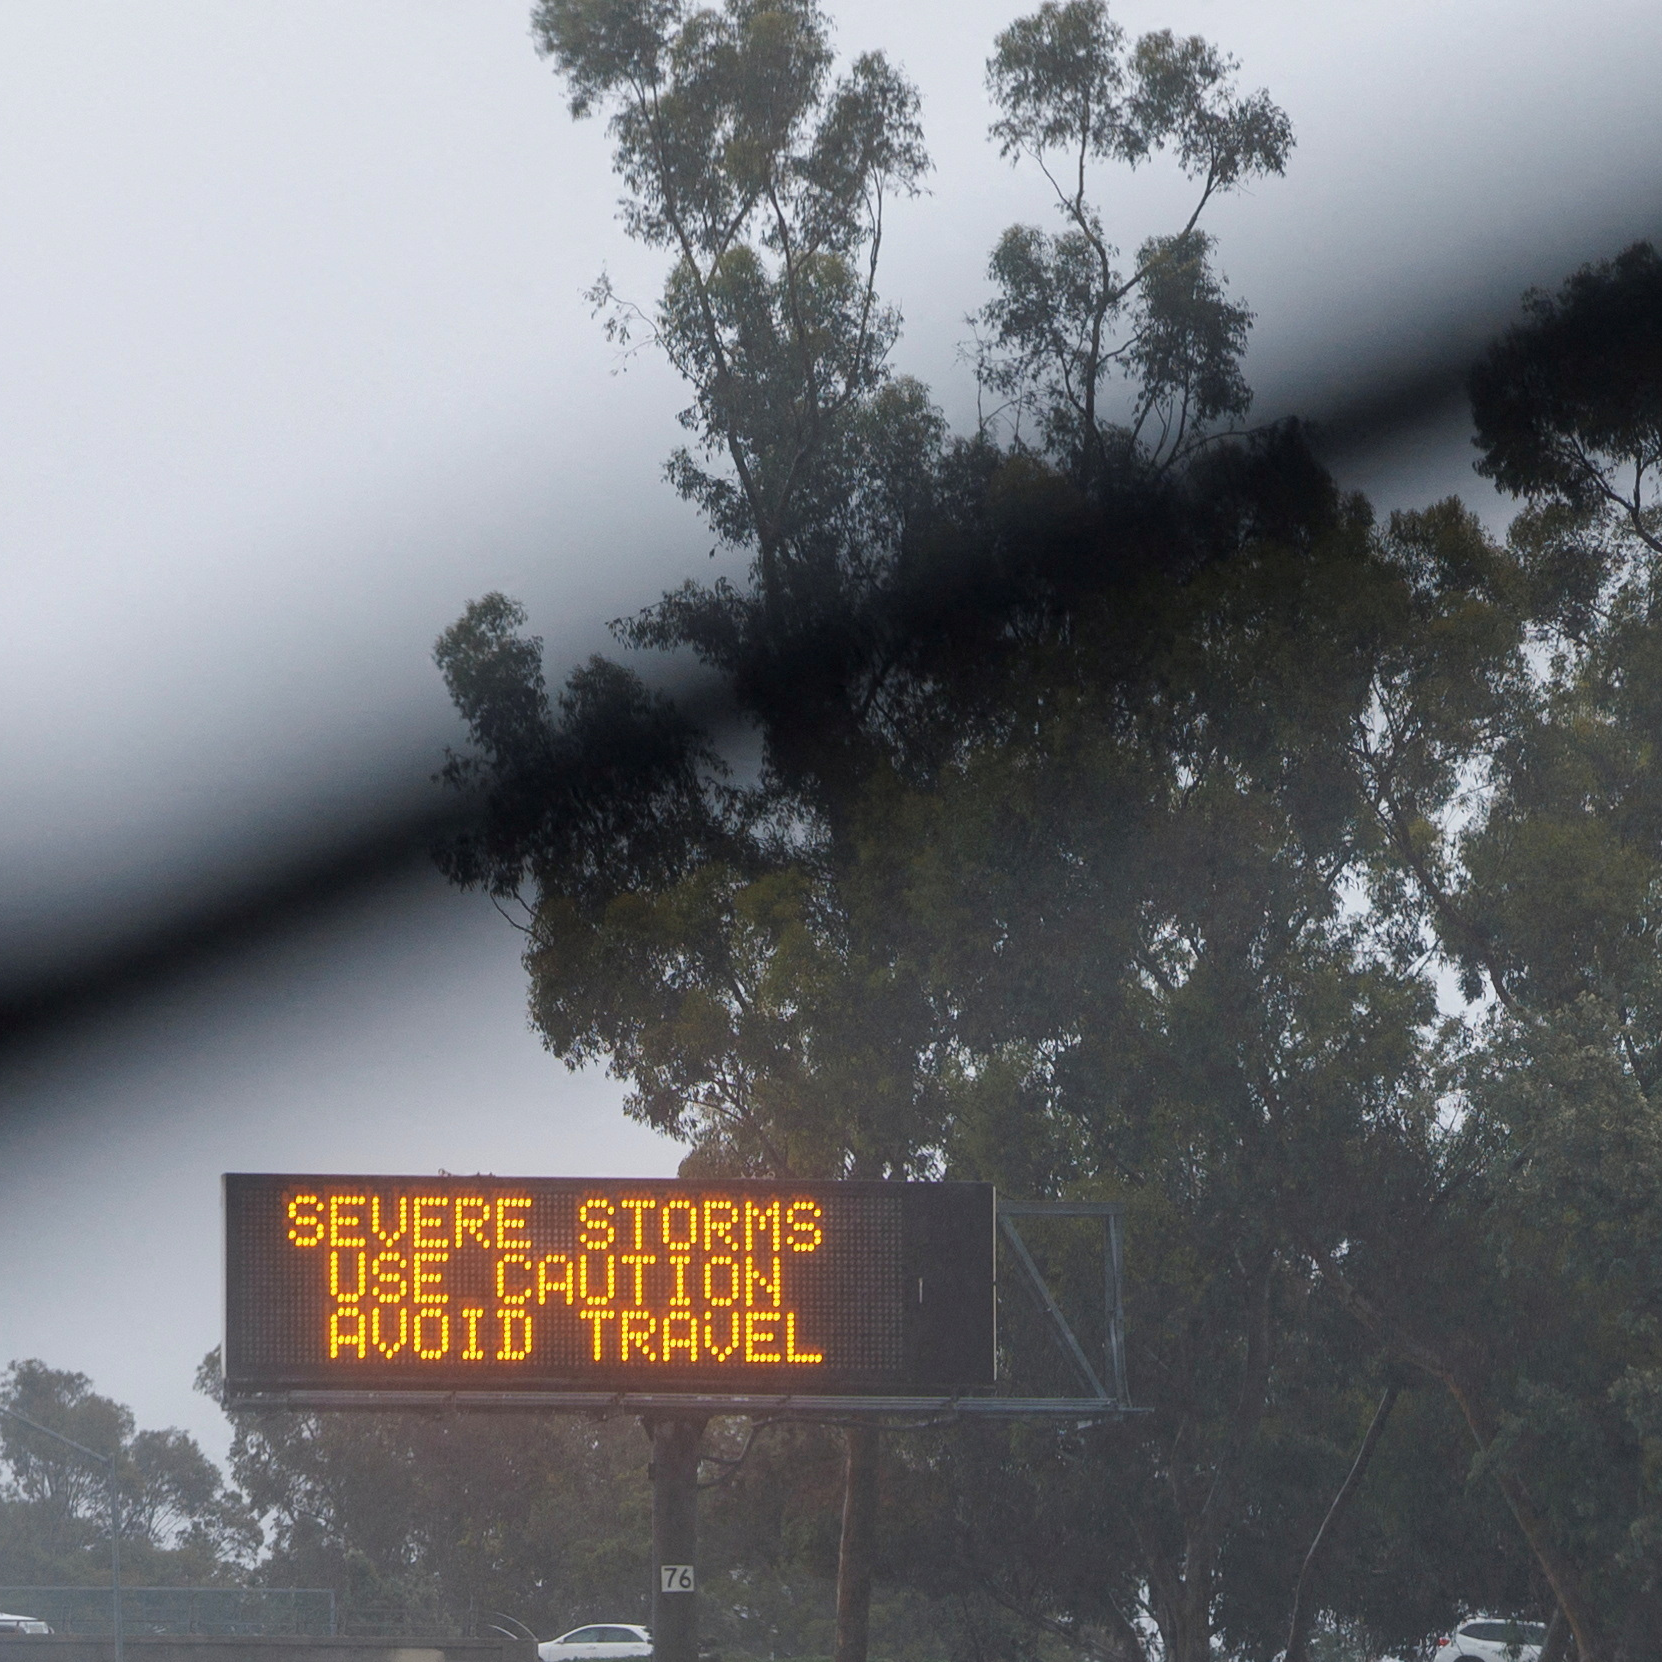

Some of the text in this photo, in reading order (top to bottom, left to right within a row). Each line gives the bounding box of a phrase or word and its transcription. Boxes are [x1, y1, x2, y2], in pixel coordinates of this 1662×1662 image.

[287, 1194, 823, 1253] SEVERE STORMS
[328, 1251, 782, 1308] USE CAUTION
[328, 1307, 823, 1365] AVOID TRAVEL
[663, 1567, 692, 1589] 76
